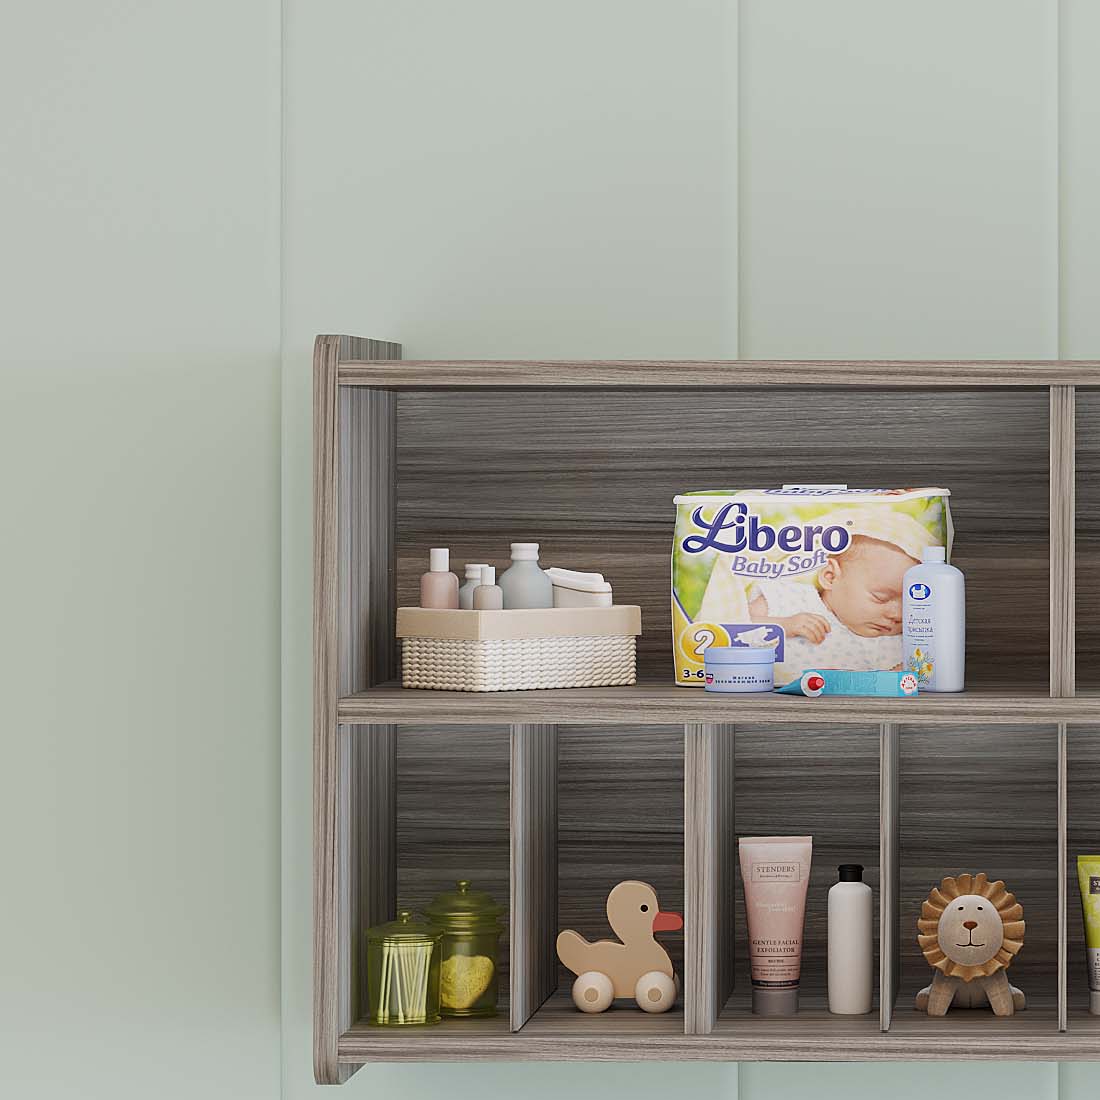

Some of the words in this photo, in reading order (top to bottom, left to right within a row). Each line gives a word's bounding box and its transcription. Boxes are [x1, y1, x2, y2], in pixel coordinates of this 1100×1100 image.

[682, 502, 849, 553] Libero
[732, 555, 785, 578] Baby
[788, 550, 828, 570] Soft
[693, 629, 716, 655] 2
